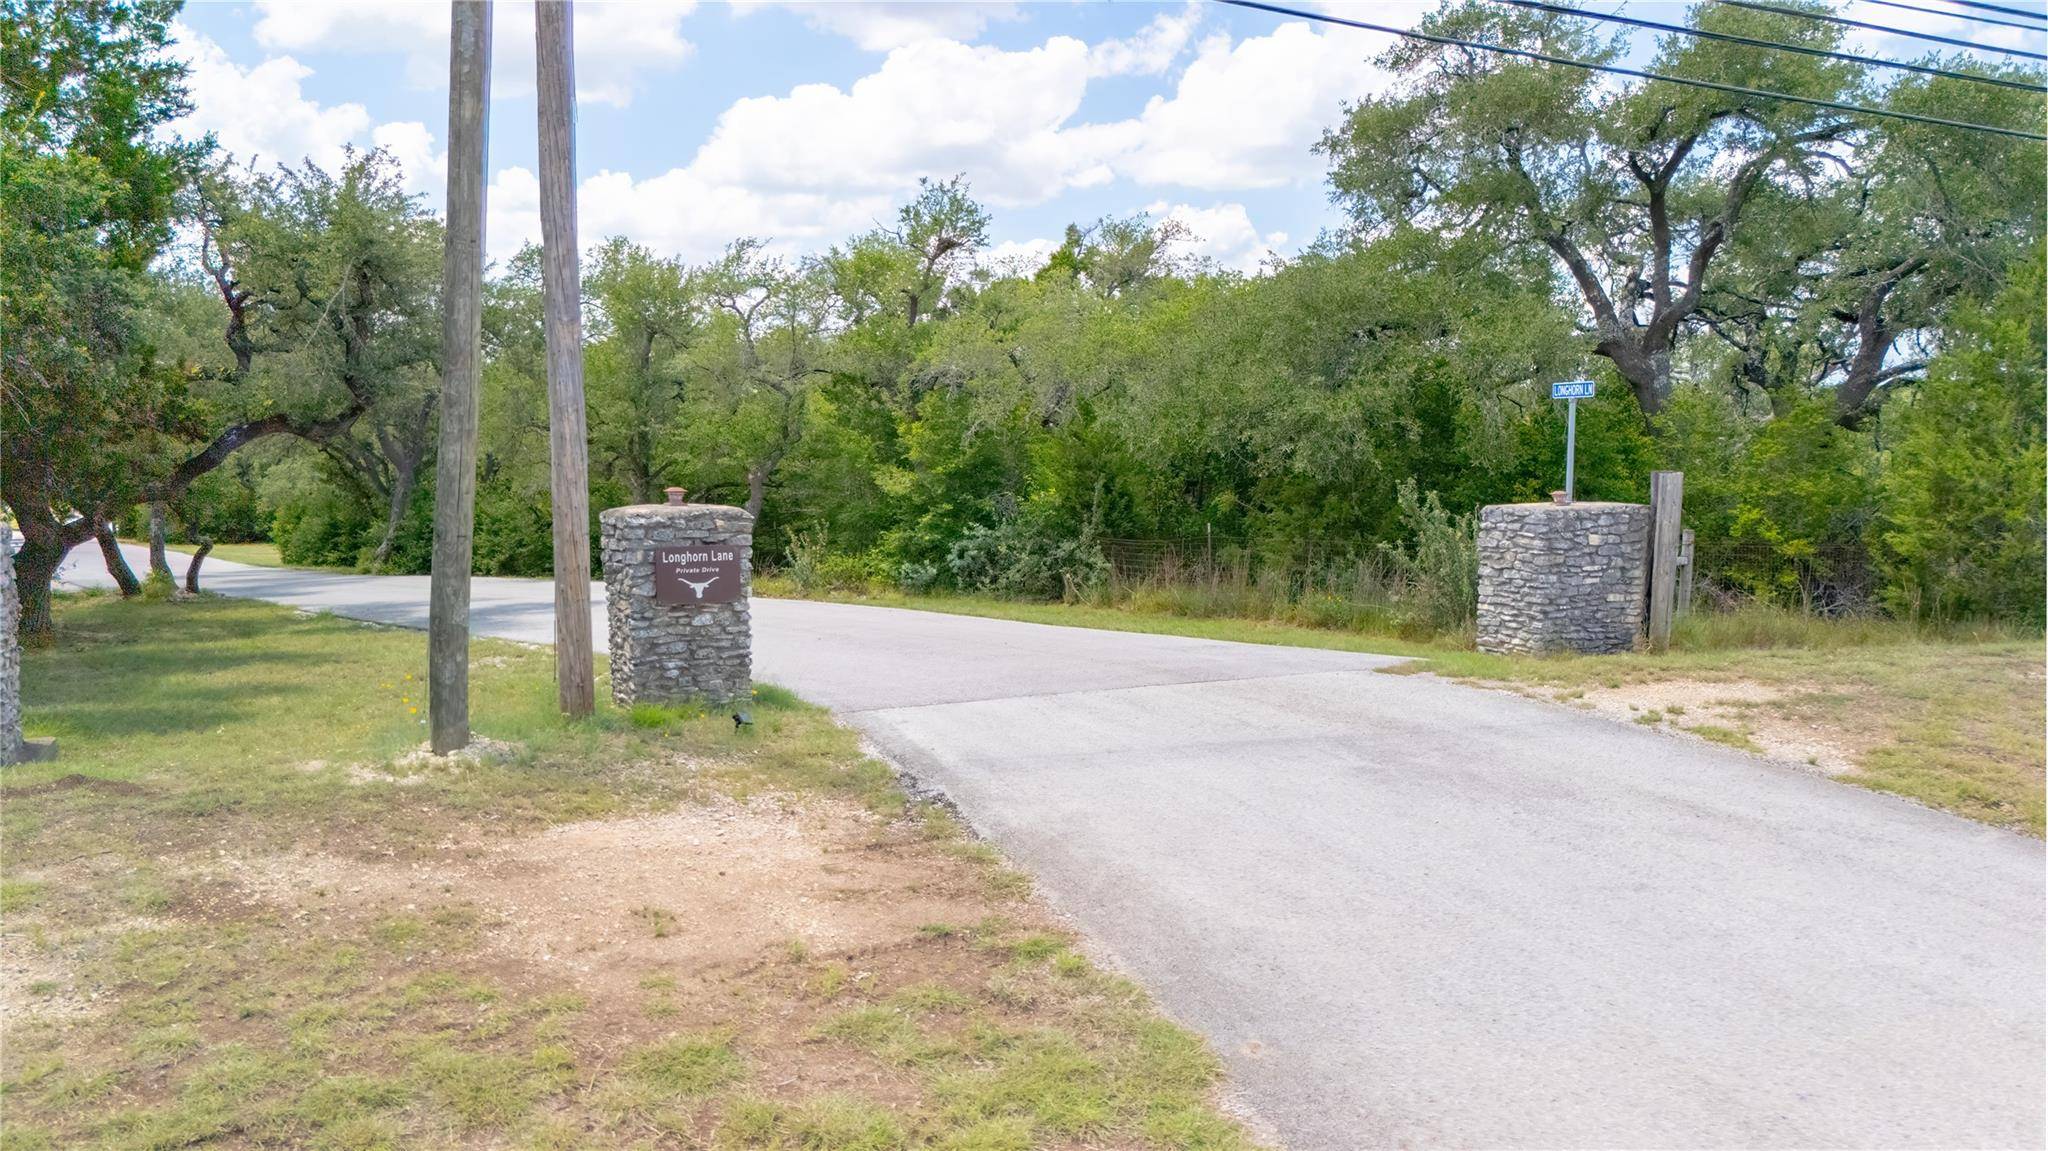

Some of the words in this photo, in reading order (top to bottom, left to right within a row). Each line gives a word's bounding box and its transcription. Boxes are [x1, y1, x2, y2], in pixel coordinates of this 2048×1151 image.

[1554, 384, 1583, 396] LONGHORN
[1585, 383, 1592, 395] LN
[662, 551, 708, 565] Longhorn
[711, 550, 733, 561] Lane
